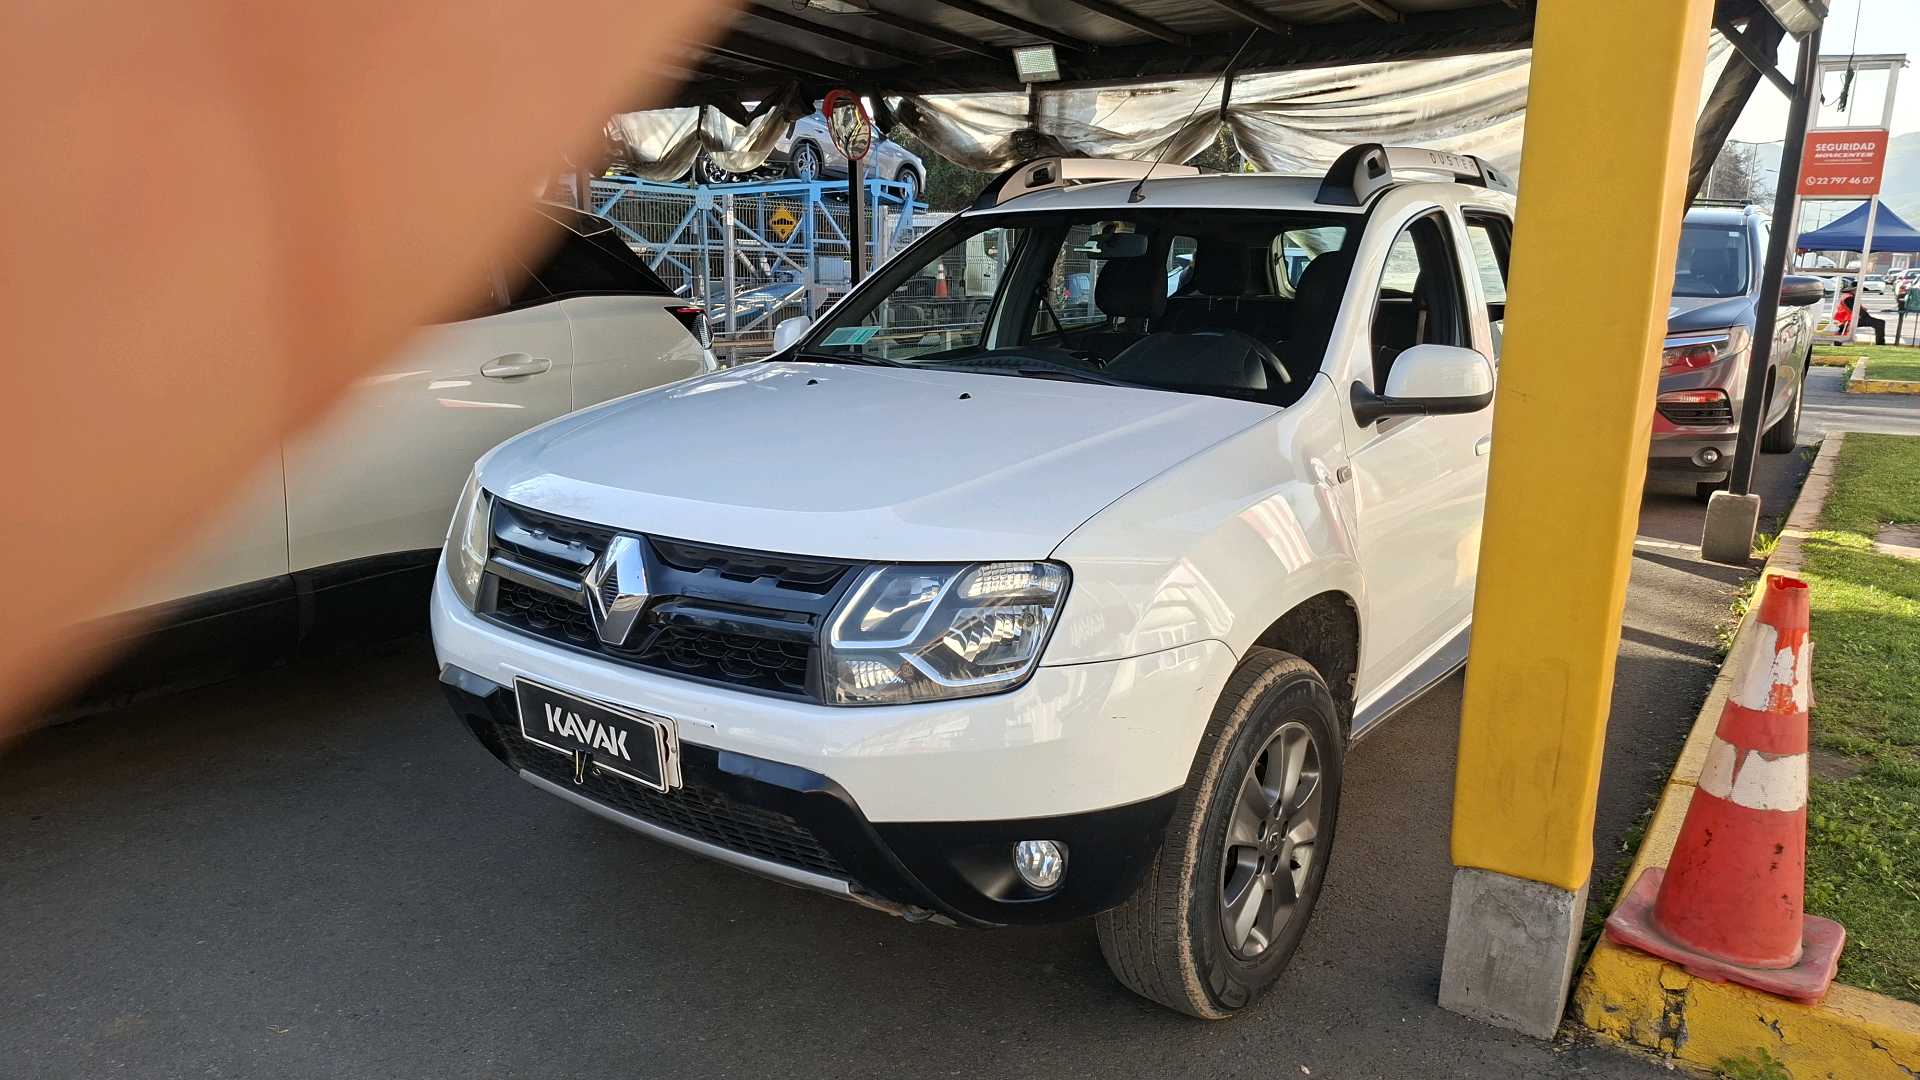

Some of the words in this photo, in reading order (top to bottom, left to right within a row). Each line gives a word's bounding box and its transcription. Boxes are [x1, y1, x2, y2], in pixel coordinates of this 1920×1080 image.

[1815, 142, 1876, 151] SEGURIDAD
[1428, 152, 1475, 170] DUSTER
[1816, 177, 1829, 185] 22
[1830, 177, 1848, 185] 797
[1848, 176, 1861, 184] 46
[1862, 176, 1875, 184] 07
[545, 702, 631, 762] KAVAK
